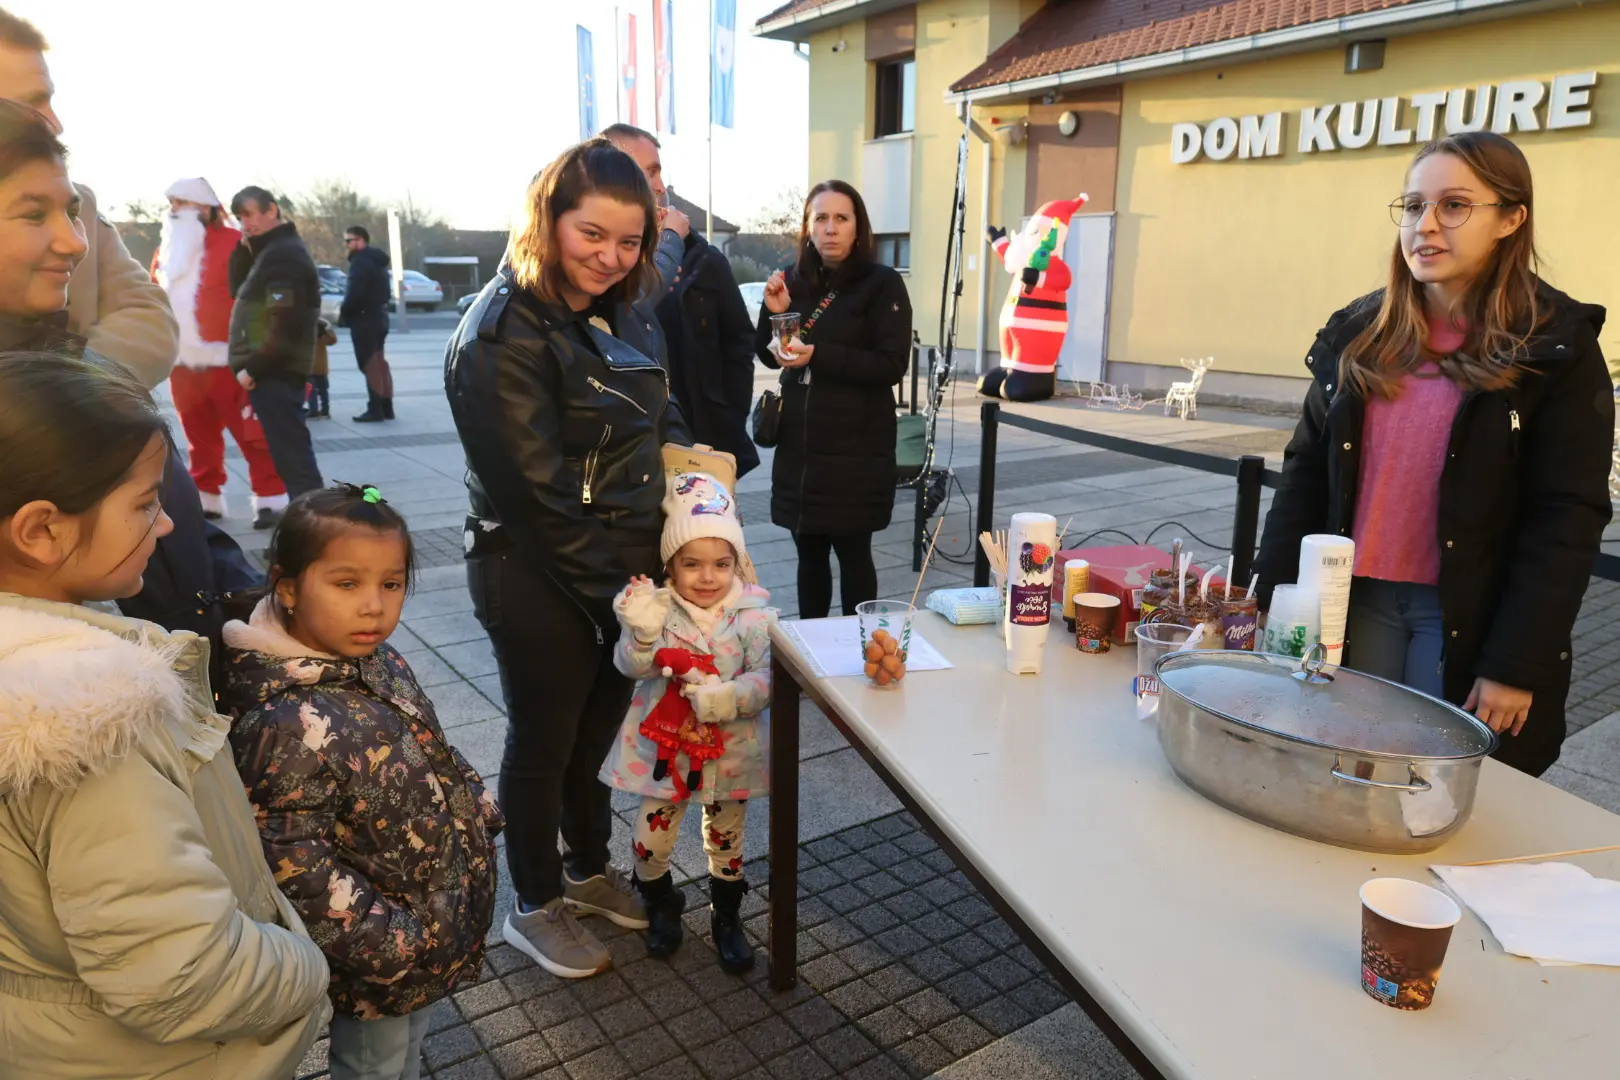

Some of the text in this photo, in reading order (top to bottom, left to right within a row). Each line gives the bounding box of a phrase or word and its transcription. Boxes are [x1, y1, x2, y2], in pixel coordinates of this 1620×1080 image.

[1170, 71, 1599, 165] DOM KULTURE
[1225, 621, 1256, 640] Milka
